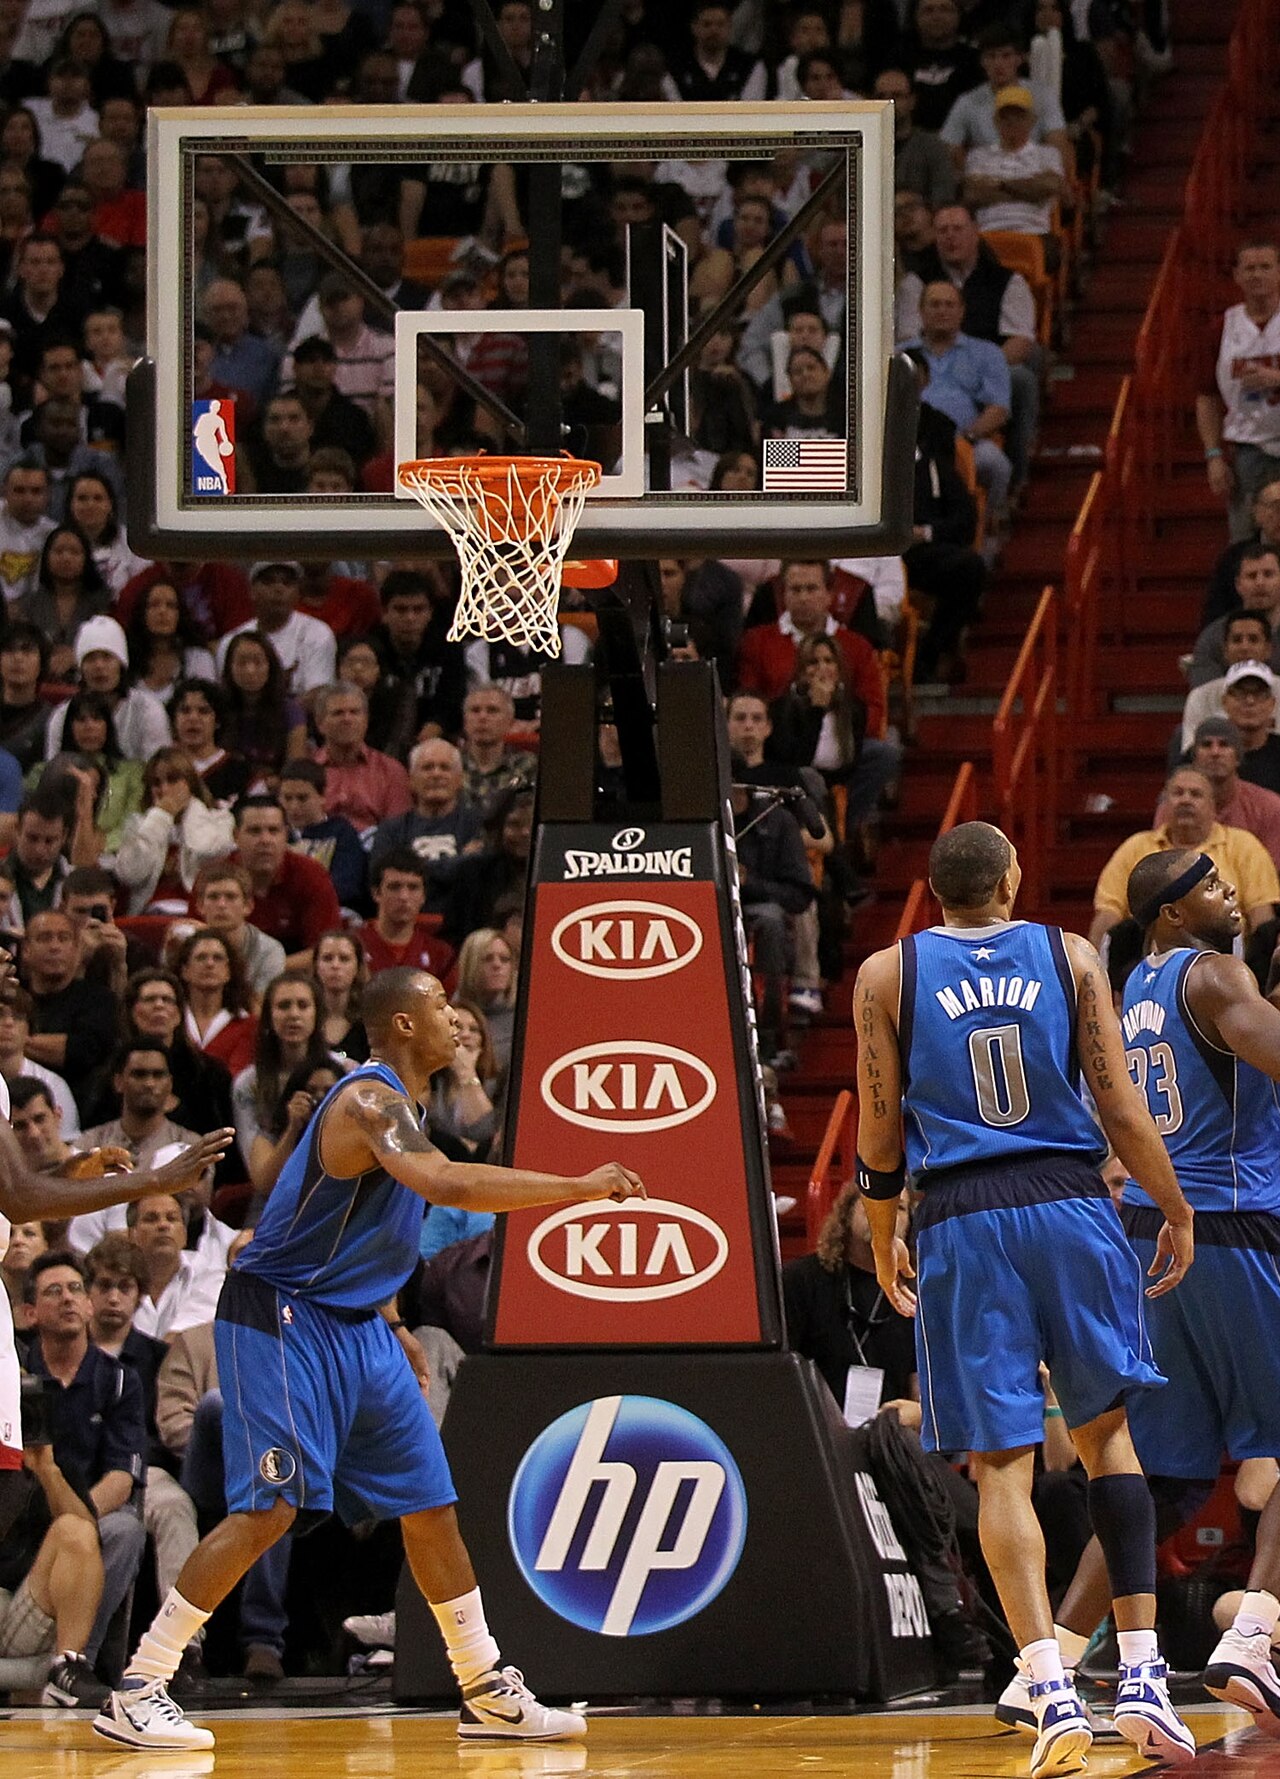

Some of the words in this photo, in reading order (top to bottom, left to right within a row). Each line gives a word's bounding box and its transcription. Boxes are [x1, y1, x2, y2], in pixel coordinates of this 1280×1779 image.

[198, 477, 222, 490] NBA
[563, 847, 694, 880] SPALDING
[579, 919, 679, 960] KIA
[934, 976, 1042, 1020] MARION
[573, 1063, 689, 1110] KIA
[968, 1023, 1030, 1127] 0
[564, 1223, 697, 1276] KIA
[534, 1395, 726, 1637] hp
